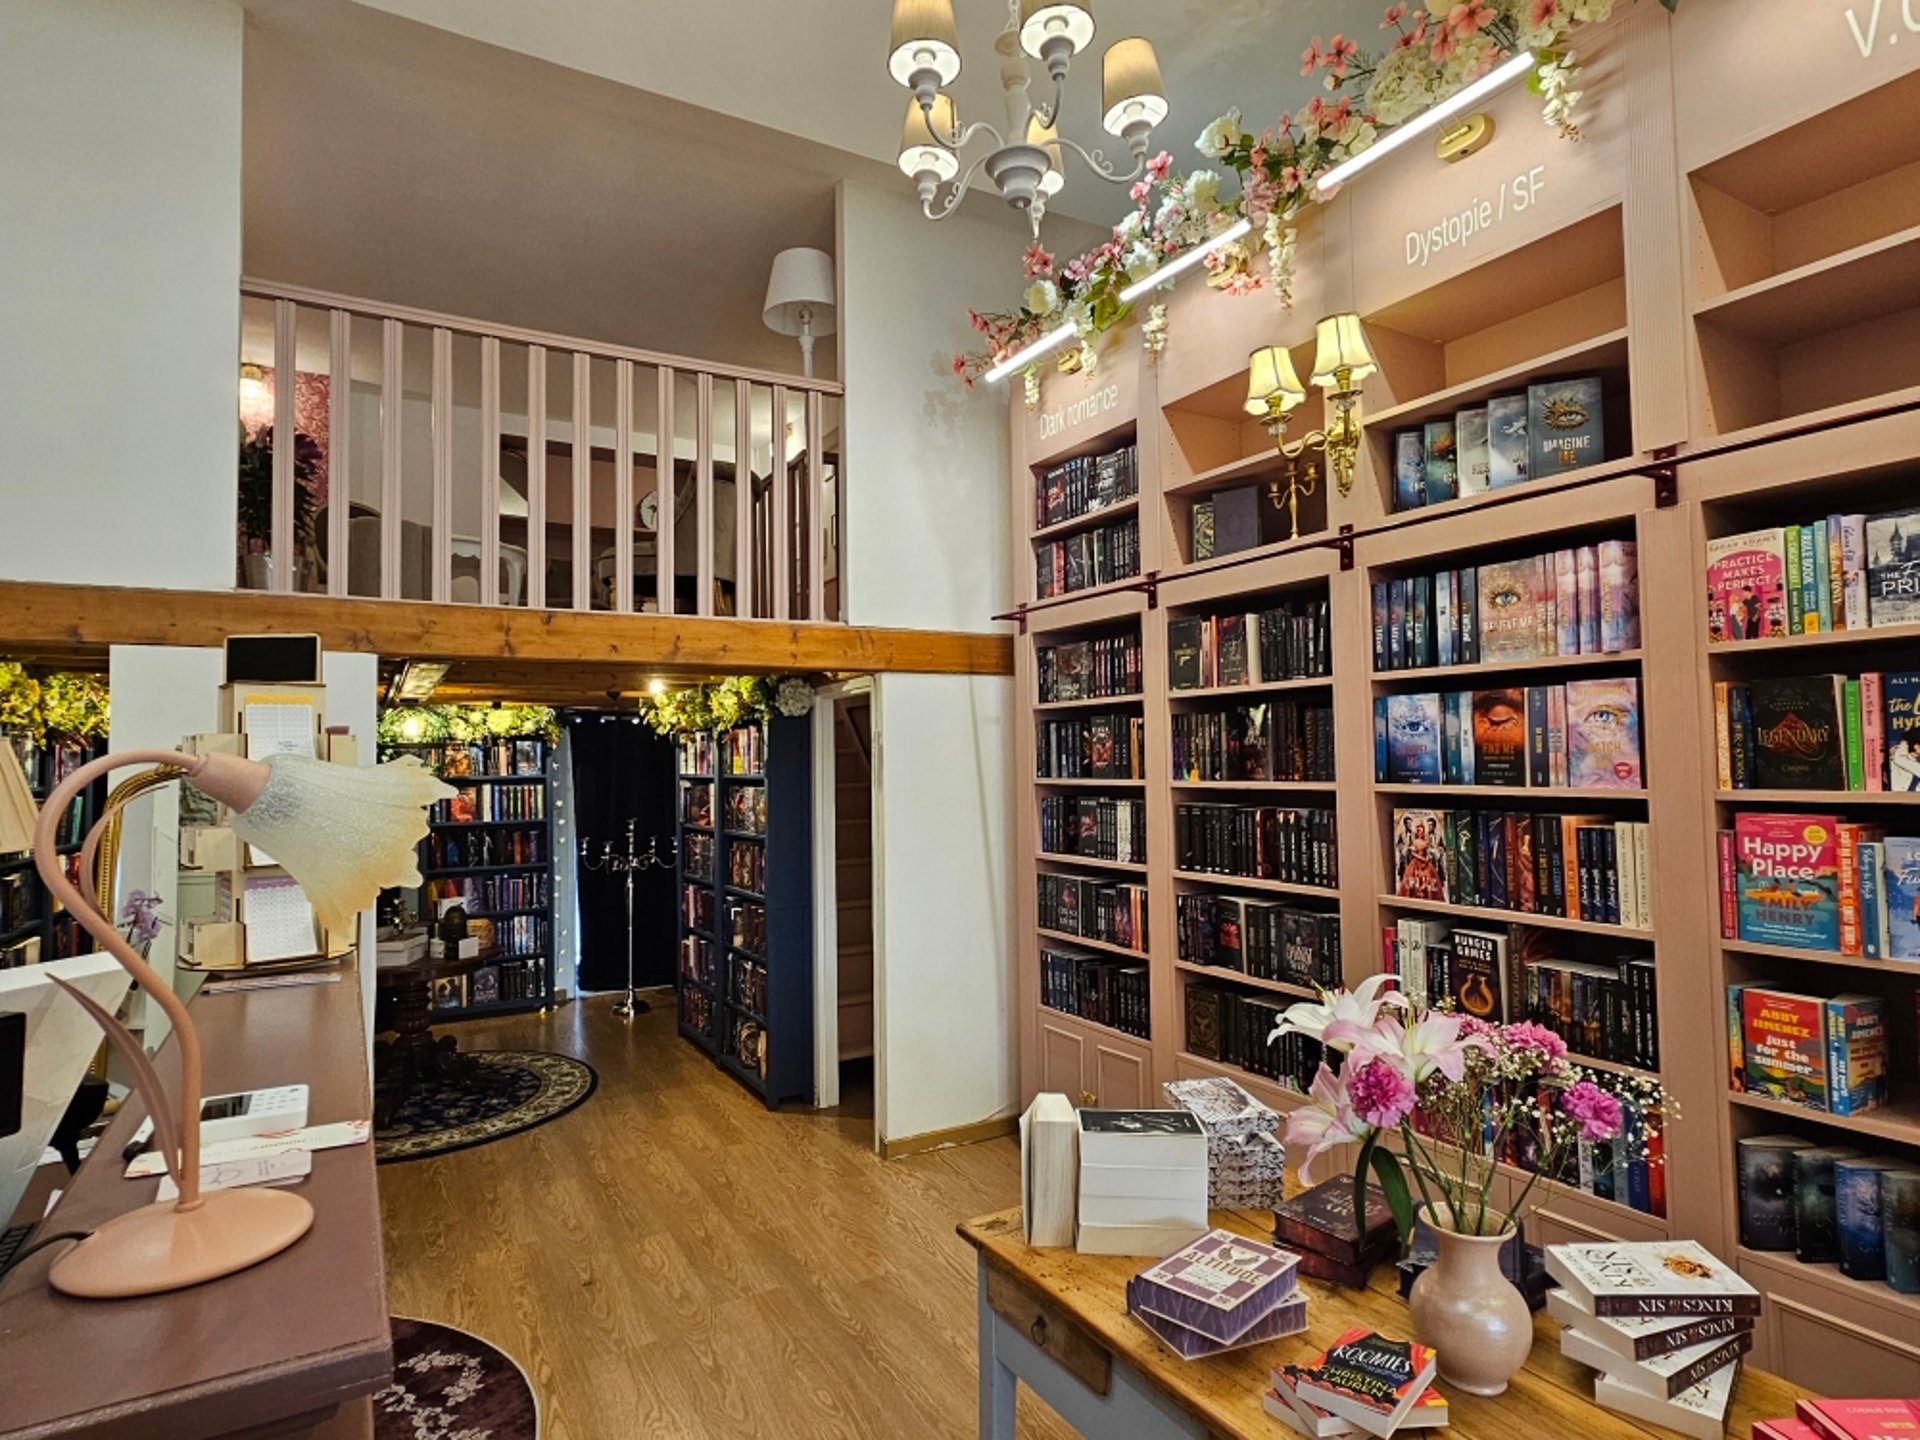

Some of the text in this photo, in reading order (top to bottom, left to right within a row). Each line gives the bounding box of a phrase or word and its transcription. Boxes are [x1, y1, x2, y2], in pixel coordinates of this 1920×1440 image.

[1405, 196, 1492, 267] Dystopie
[1512, 166, 1546, 211] SF
[1039, 383, 1119, 441] Dark romance
[1543, 434, 1592, 454] IMAGINE
[1713, 552, 1774, 571] PRACTICE
[1722, 564, 1766, 579] MAKES
[1717, 575, 1771, 591] PERFECT
[1757, 724, 1830, 749] LEGENDARY
[1743, 836, 1823, 863] Happy
[1751, 857, 1815, 880] Place
[1757, 897, 1811, 911] EMILY
[1755, 909, 1815, 926] HENRY
[1454, 934, 1493, 951] HUNGER
[1456, 946, 1492, 962] GAMES
[1760, 1008, 1800, 1024] ABBY
[1752, 1018, 1812, 1038] JIMENEZ
[1756, 1043, 1810, 1064] for the
[1753, 1055, 1813, 1076] summer
[1183, 1250, 1264, 1283] ALTITUDE
[1638, 1298, 1667, 1313] SIN
[1681, 1298, 1734, 1313] KINGS
[1697, 1316, 1736, 1336] KINGS
[1665, 1330, 1689, 1349] SIN
[1332, 1343, 1411, 1374] ROOMIES
[1320, 1364, 1397, 1394] CHRISTINA
[1322, 1372, 1384, 1398] LAUREN
